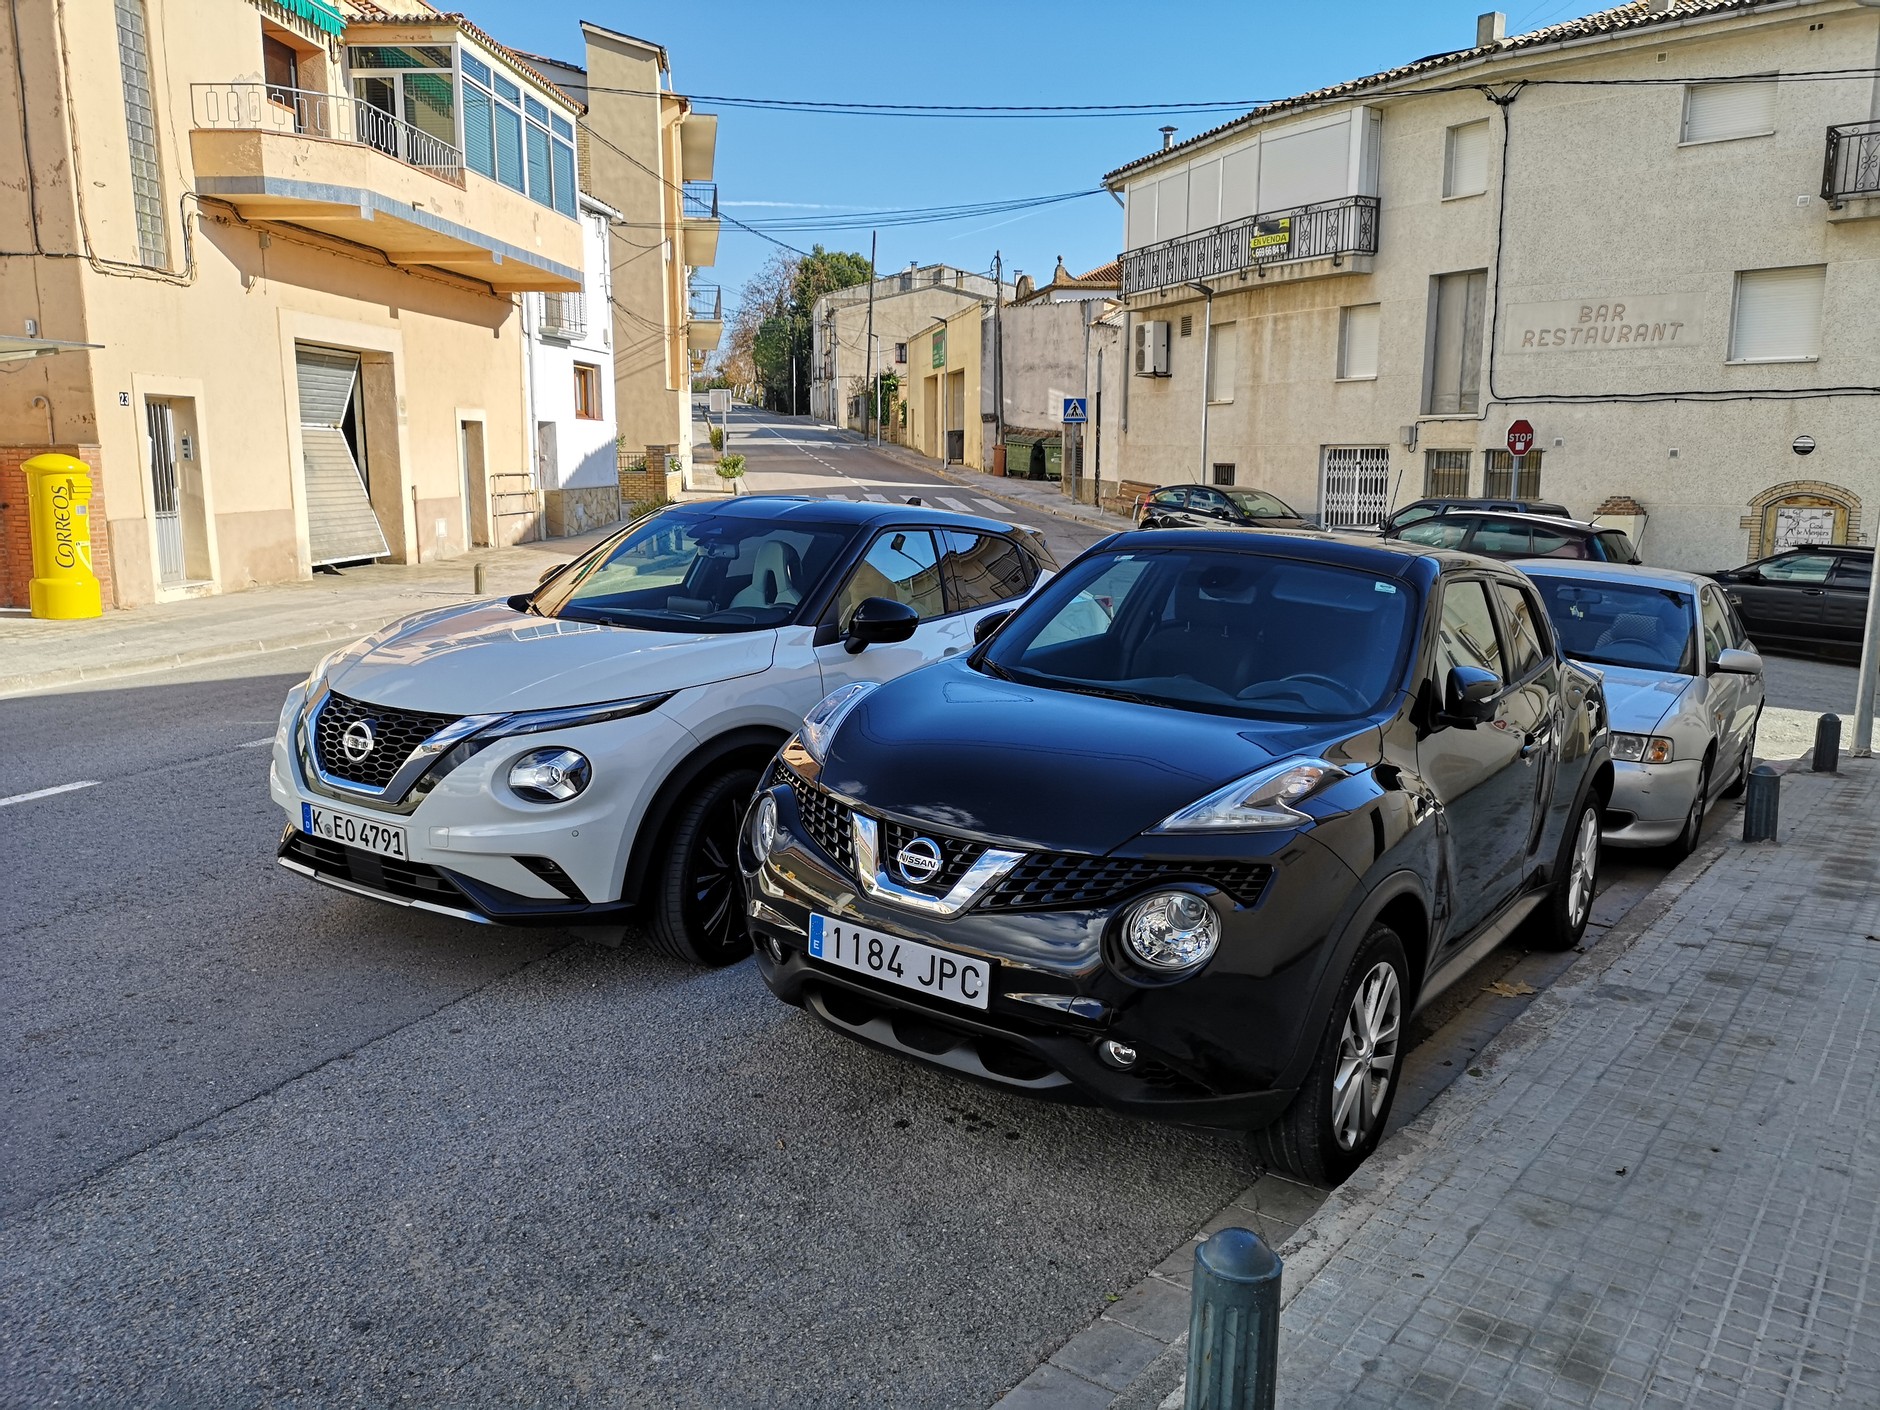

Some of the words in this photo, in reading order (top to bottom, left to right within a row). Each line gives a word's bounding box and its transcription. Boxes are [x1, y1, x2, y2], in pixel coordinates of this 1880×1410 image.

[1253, 237, 1261, 246] EN
[1262, 234, 1287, 244] VENDA
[1578, 303, 1626, 323] BAR
[1521, 321, 1684, 348] RESTAURANT
[120, 393, 129, 405] 23
[1509, 433, 1532, 442] STOP
[51, 485, 75, 568] CORREOS
[312, 808, 324, 834] K
[359, 822, 404, 856] 4791
[899, 853, 937, 869] NISSAN
[813, 939, 820, 950] E
[833, 927, 904, 978] 1184
[917, 954, 980, 999] JPC
